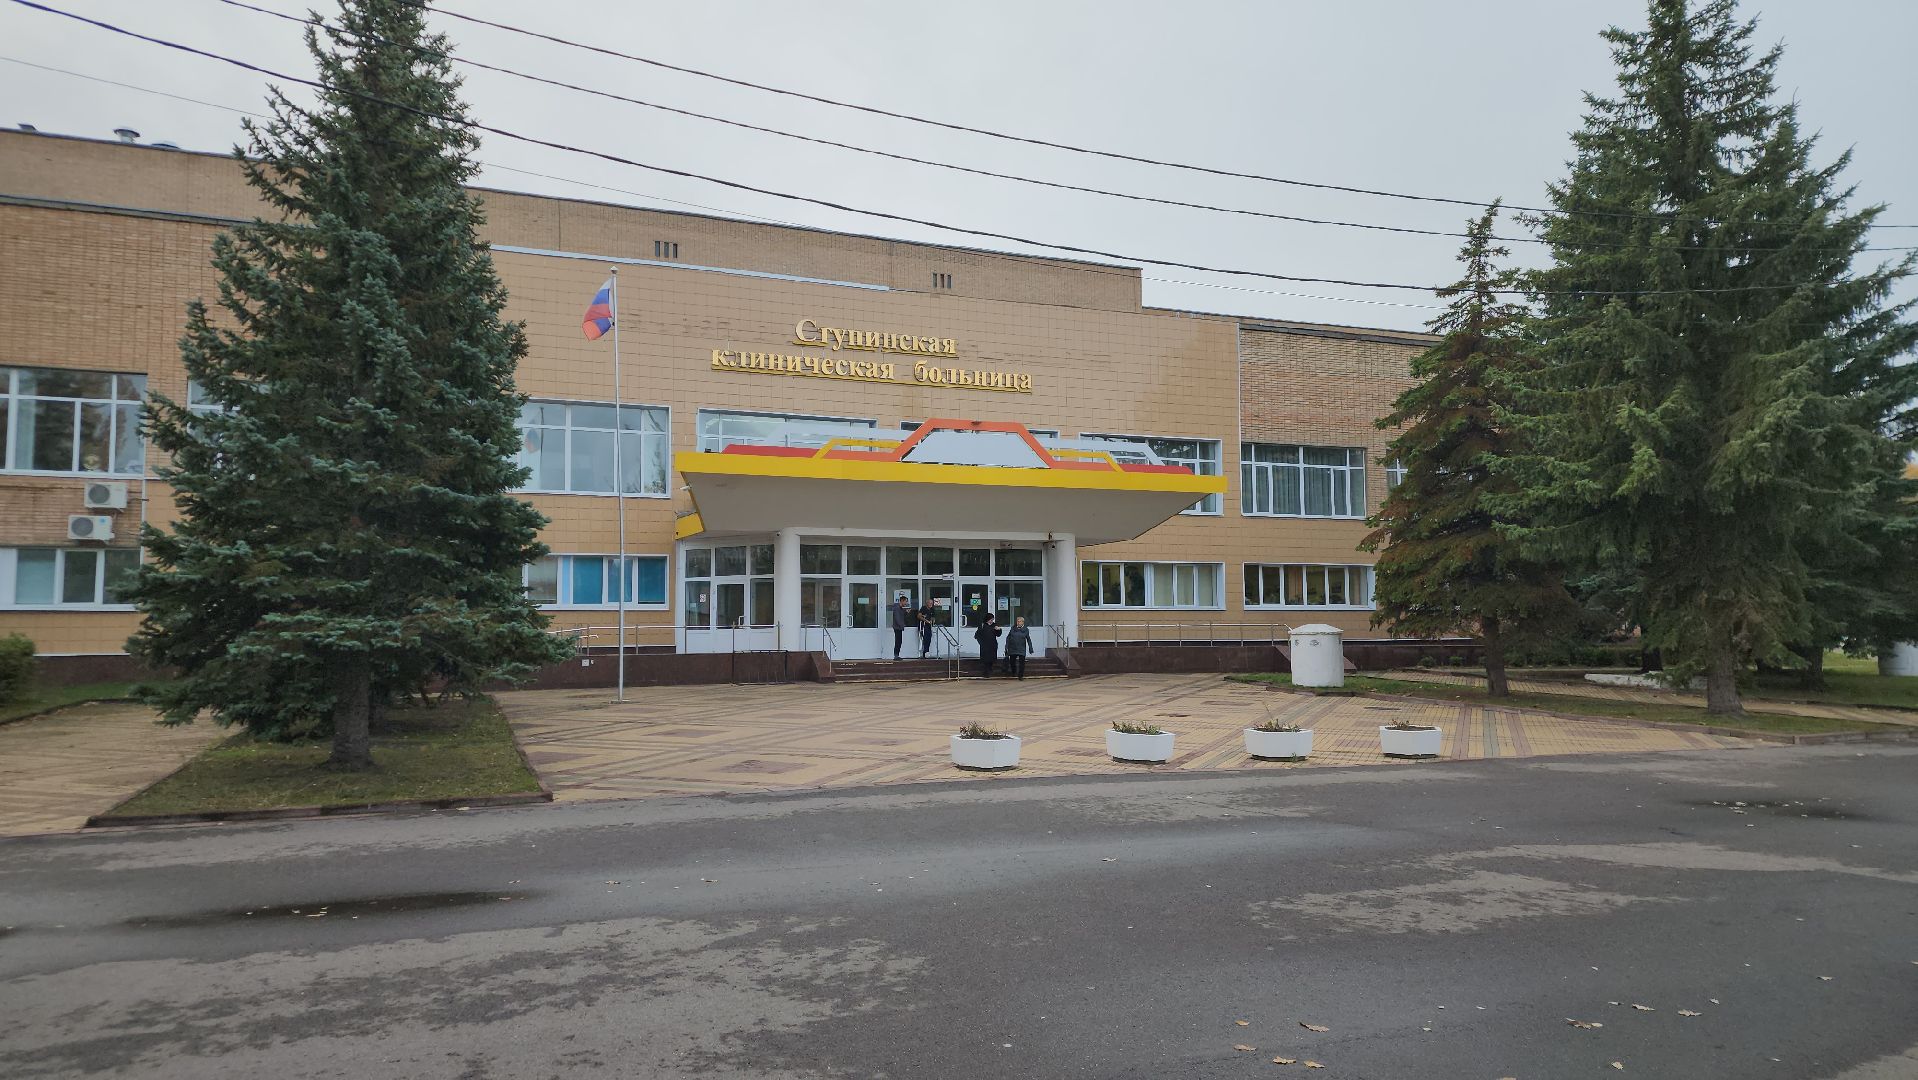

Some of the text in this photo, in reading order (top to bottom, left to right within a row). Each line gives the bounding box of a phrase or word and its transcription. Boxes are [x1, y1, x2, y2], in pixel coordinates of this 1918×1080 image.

[795, 319, 959, 354] Ступинская
[712, 348, 1033, 392] клиническая больница
